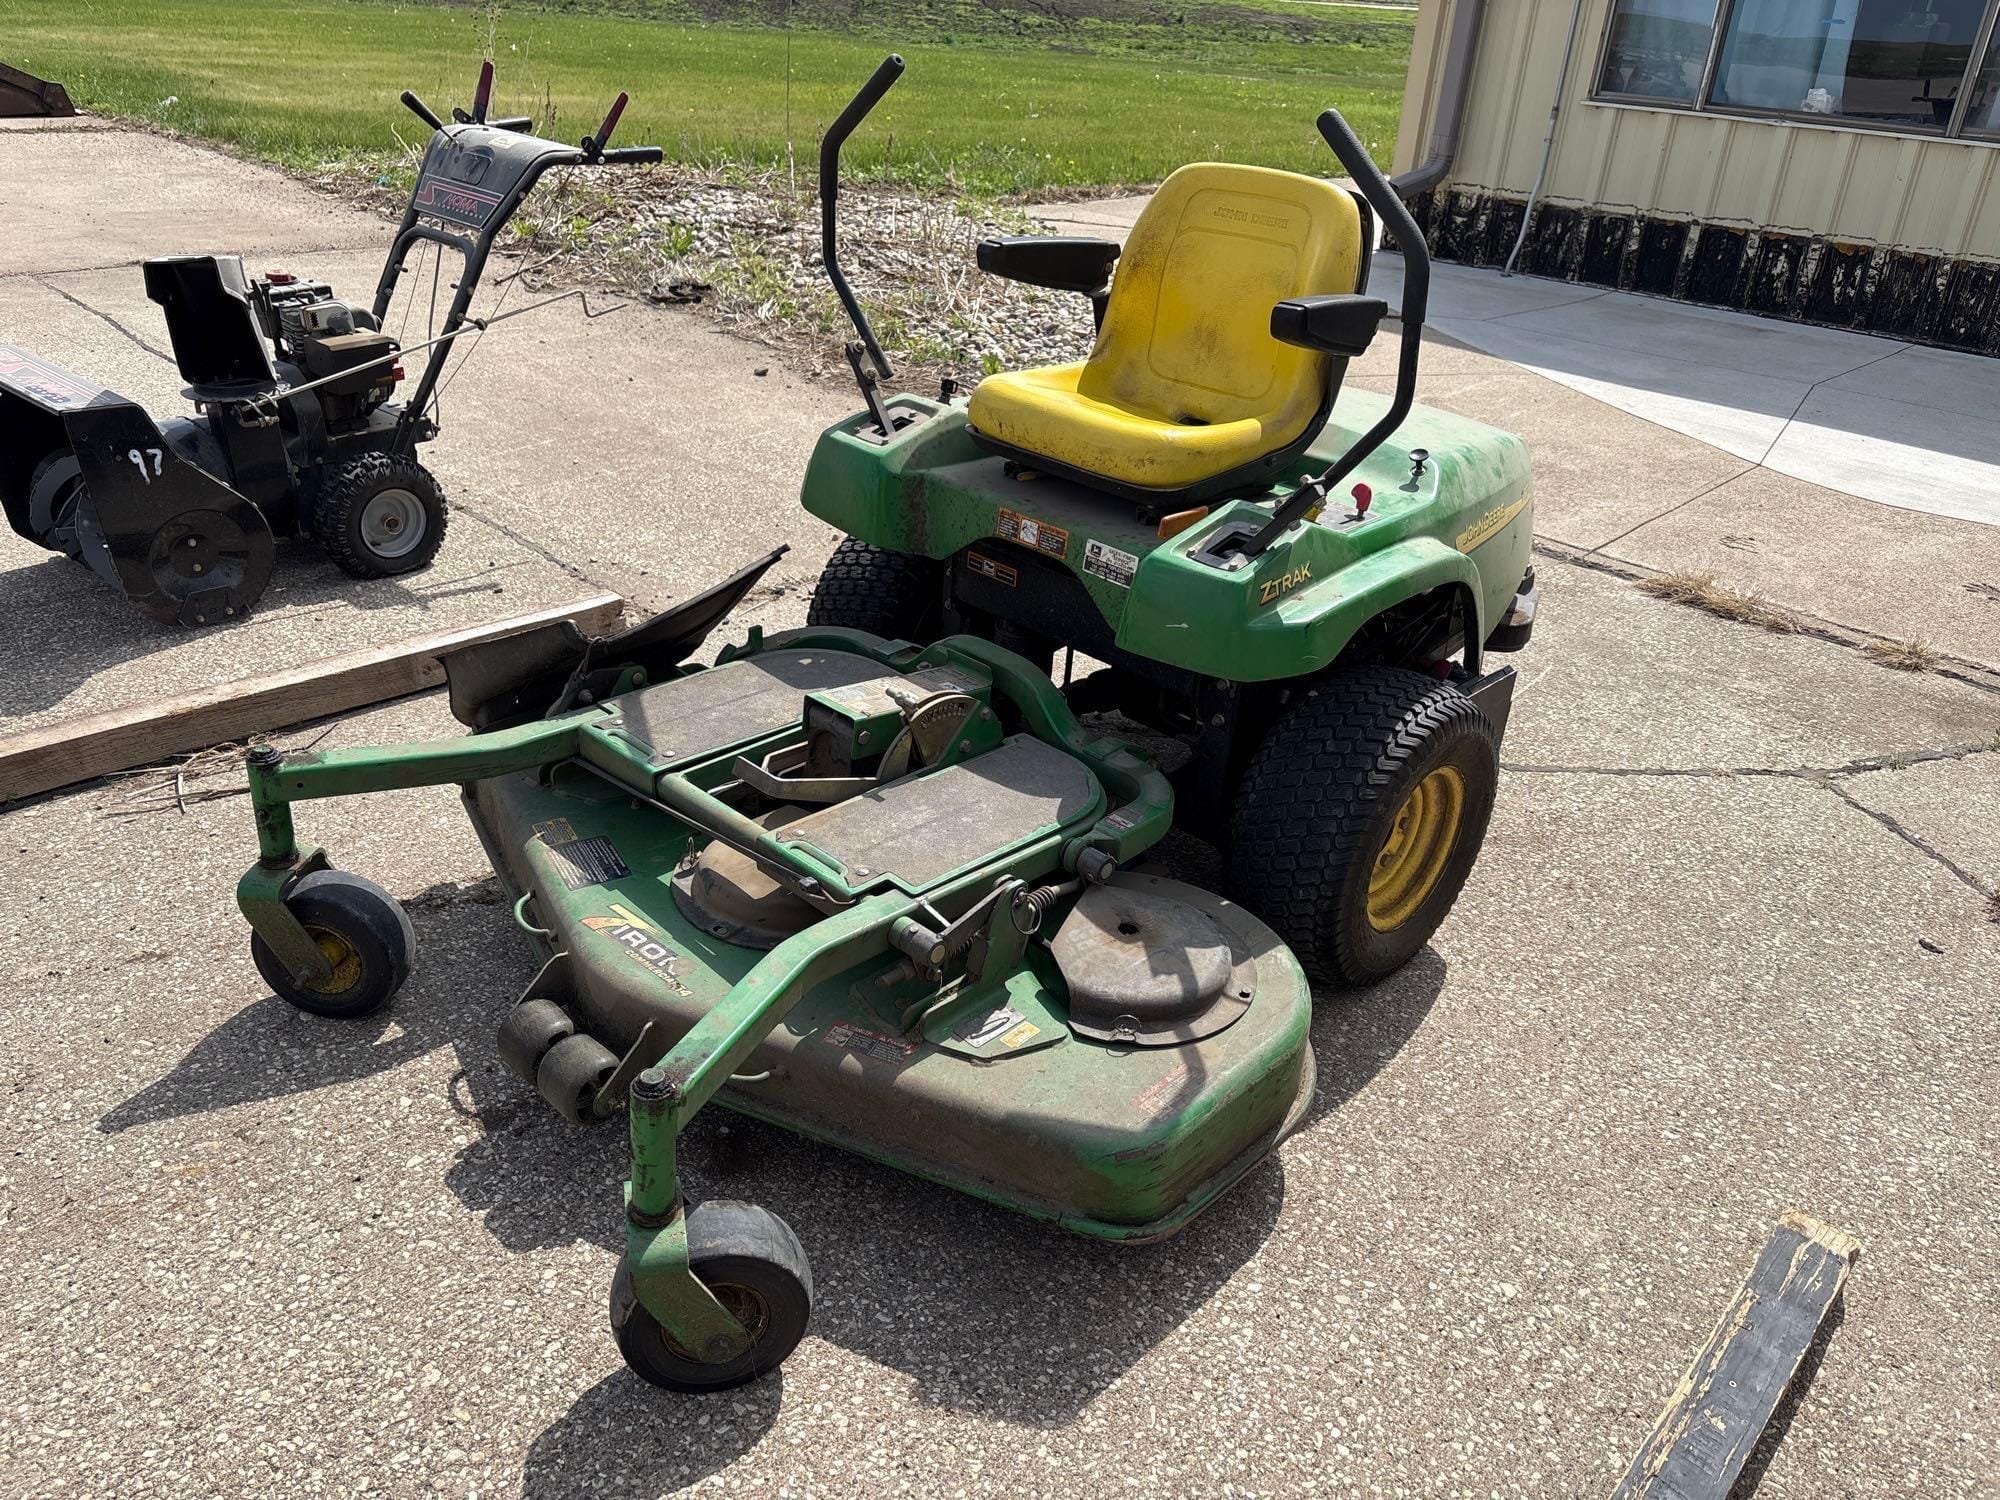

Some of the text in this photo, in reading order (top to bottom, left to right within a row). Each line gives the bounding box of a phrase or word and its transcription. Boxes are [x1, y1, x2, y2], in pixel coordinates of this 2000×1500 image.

[441, 193, 480, 213] NOMA
[128, 448, 162, 486] 97
[1462, 503, 1505, 546] JOHN DEERE
[624, 949, 679, 988] COMMERCIA
